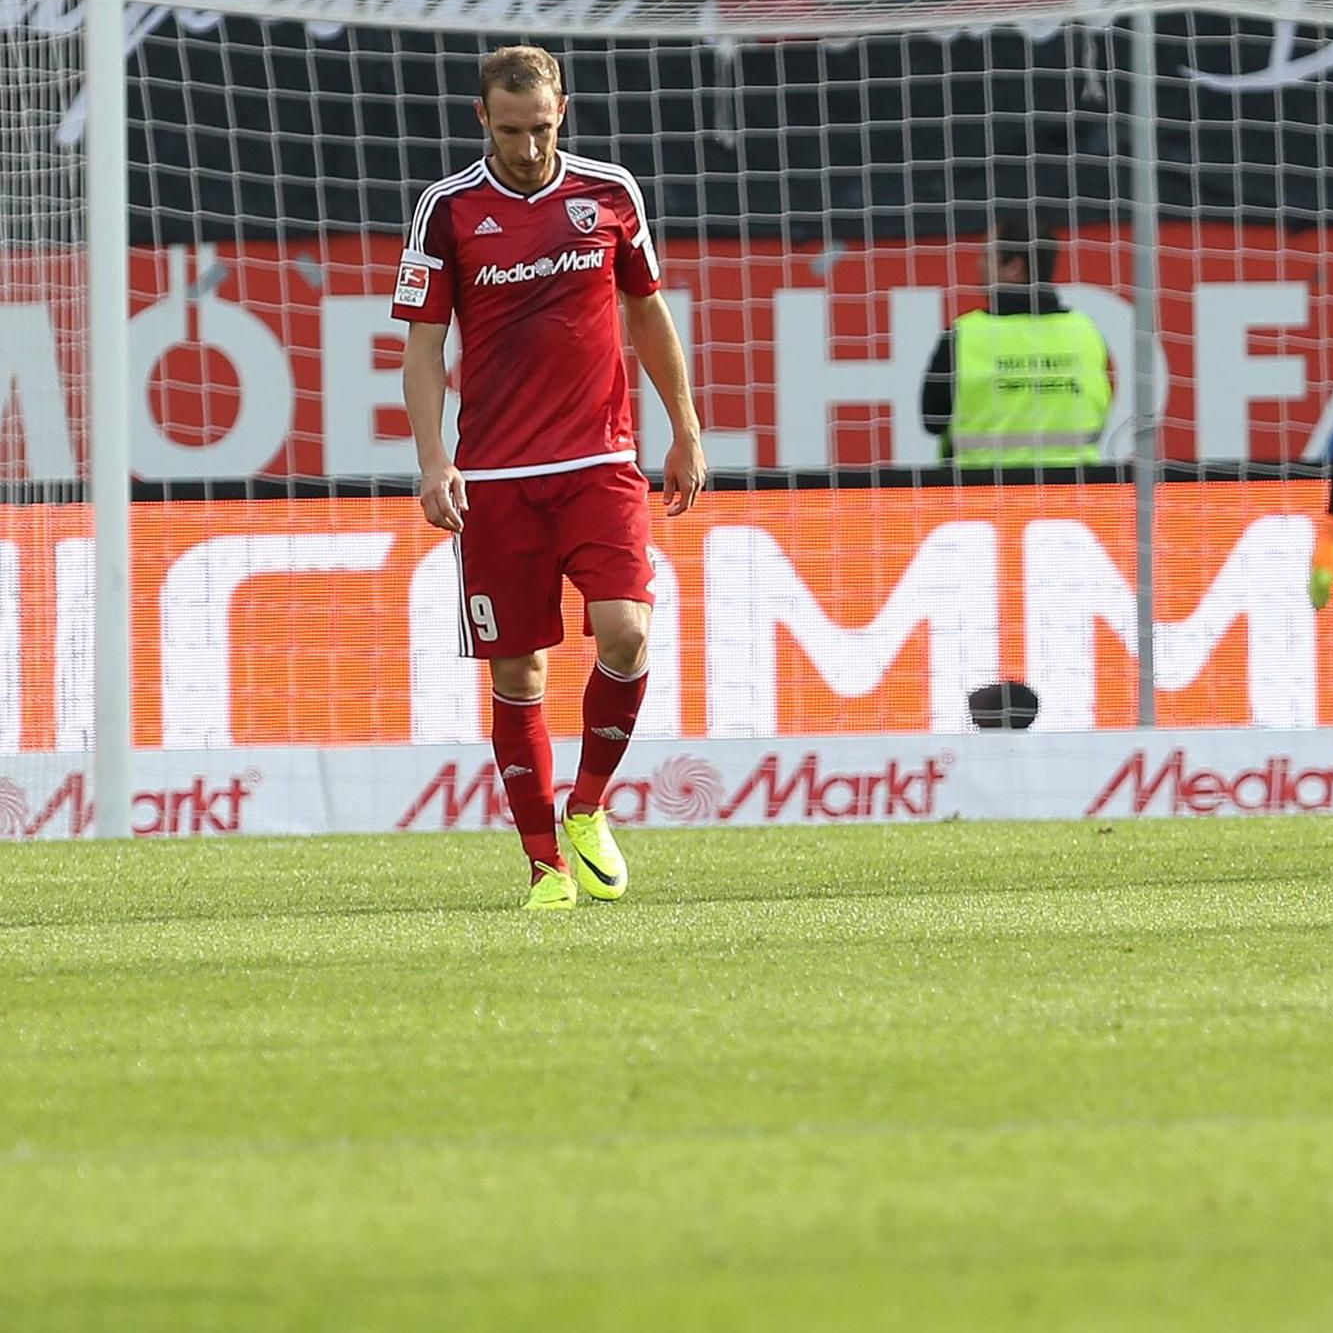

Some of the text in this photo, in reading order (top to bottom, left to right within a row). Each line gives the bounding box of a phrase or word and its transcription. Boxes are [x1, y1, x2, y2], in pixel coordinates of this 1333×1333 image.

[474, 249, 605, 286] Media Markt
[469, 593, 498, 643] 9
[25, 771, 254, 838] Markt
[718, 752, 945, 822] Markt
